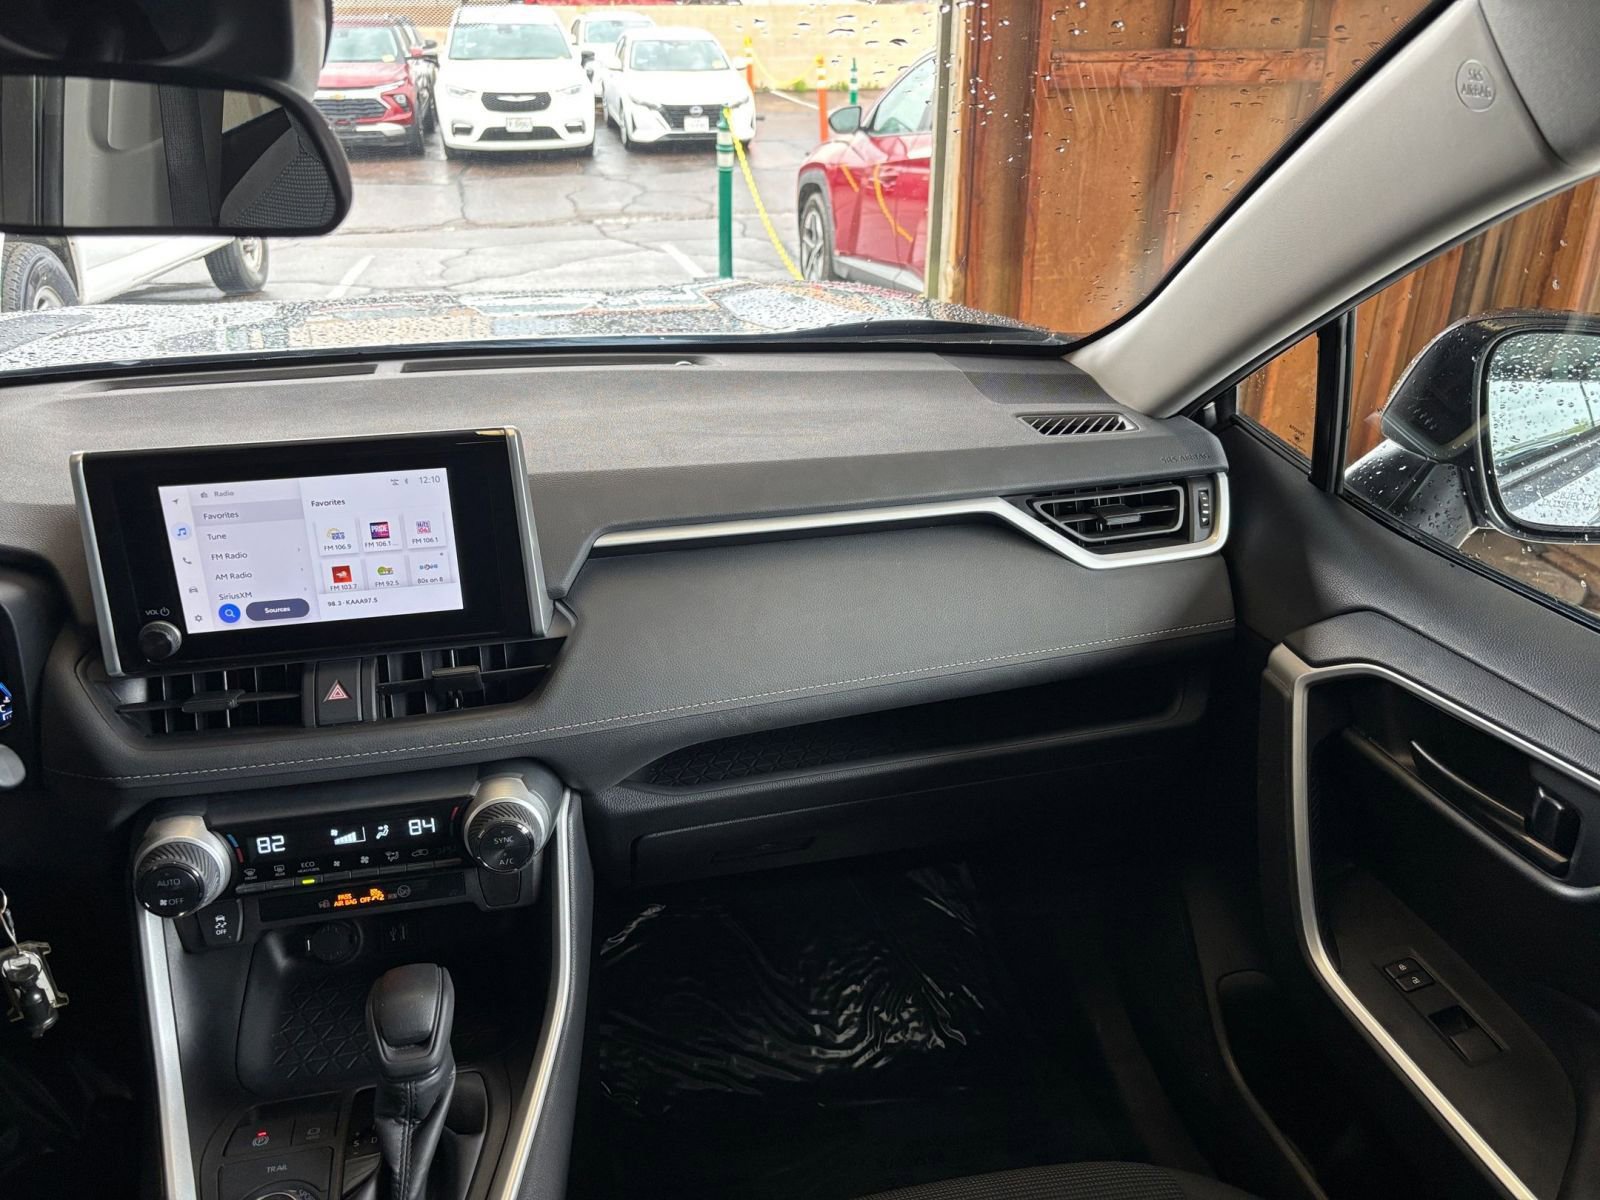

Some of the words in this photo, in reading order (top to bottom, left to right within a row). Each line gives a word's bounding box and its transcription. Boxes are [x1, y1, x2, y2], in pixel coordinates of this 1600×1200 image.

[419, 475, 441, 484] 12:10
[214, 490, 234, 498] Radio
[311, 499, 346, 507] Favorites
[203, 511, 239, 520] Favorites
[207, 533, 227, 541] Tune
[211, 553, 223, 561] FM
[225, 551, 248, 560] Radio
[215, 573, 228, 581] AM
[229, 571, 252, 580] Radio
[218, 591, 253, 601] SiriusXM
[264, 606, 291, 614] Sources
[408, 817, 436, 836] 84
[256, 835, 286, 854] 82
[493, 835, 514, 845] SYNC
[157, 878, 181, 887] AUTO
[168, 897, 184, 905] OFF
[266, 1164, 288, 1173] TRAIL
